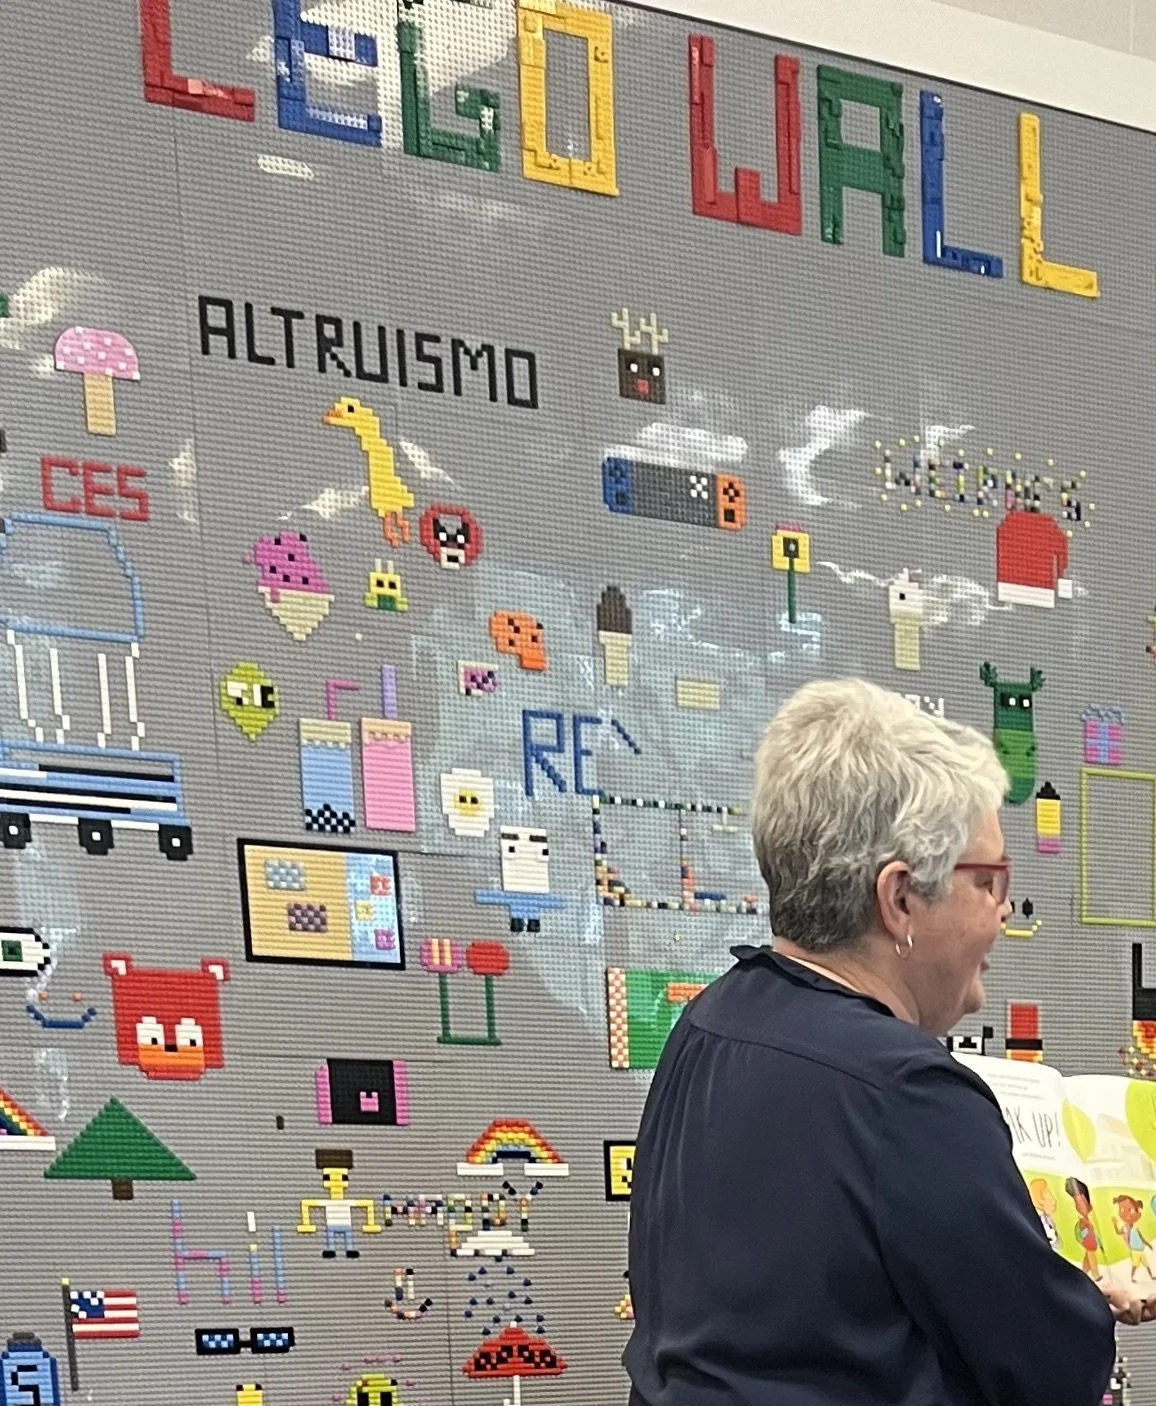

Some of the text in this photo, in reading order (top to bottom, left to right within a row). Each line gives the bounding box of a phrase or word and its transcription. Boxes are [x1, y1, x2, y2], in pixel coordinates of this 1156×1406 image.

[139, 0, 1099, 298] LEGO WALL
[198, 295, 539, 409] ALTRUISMO
[41, 455, 150, 522] CES
[1031, 1110, 1061, 1148] UP!
